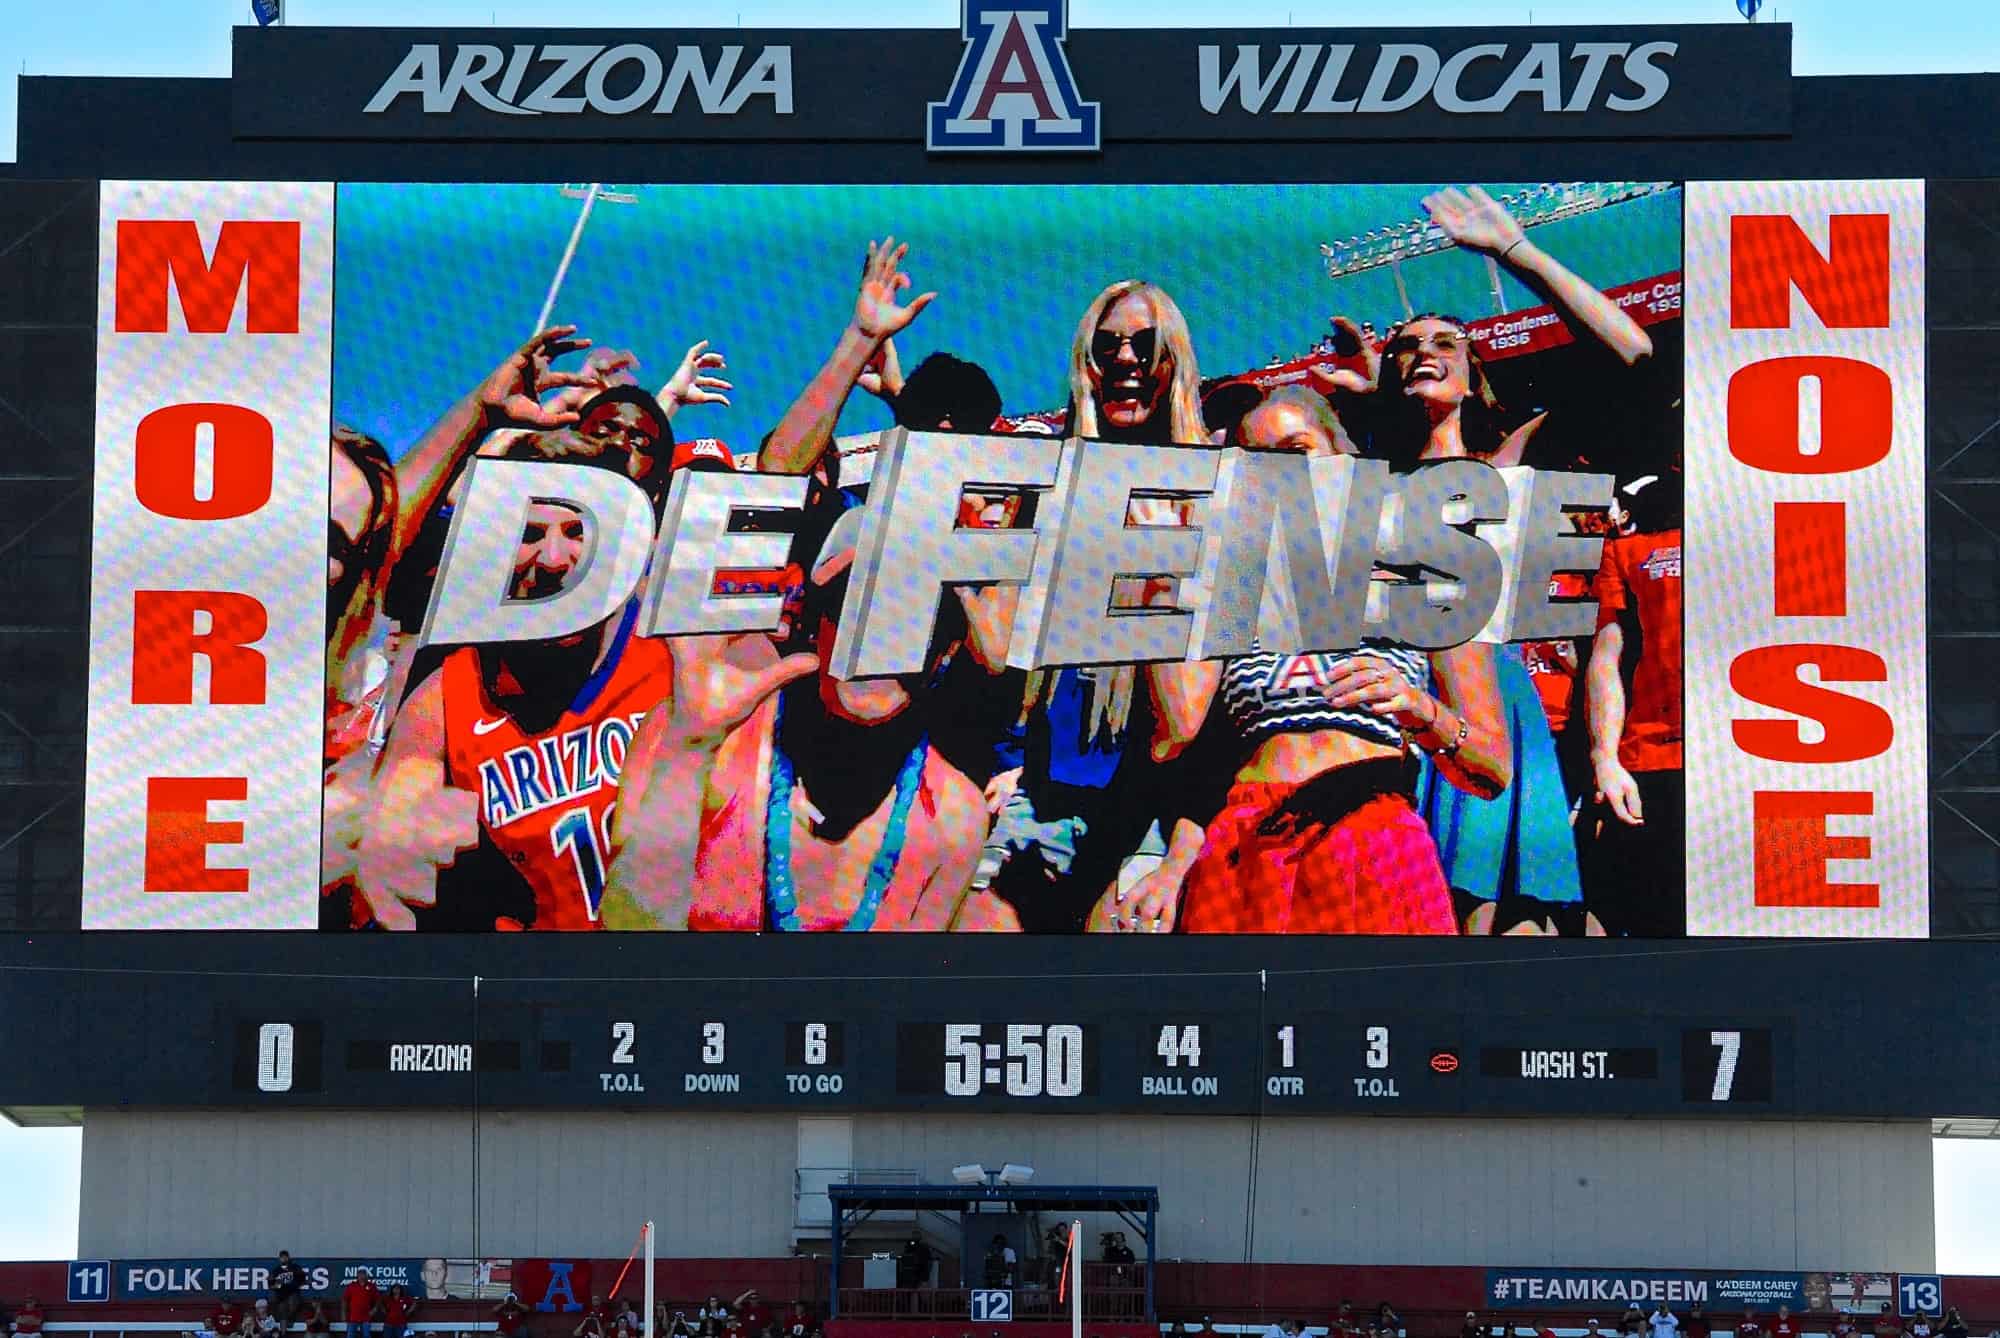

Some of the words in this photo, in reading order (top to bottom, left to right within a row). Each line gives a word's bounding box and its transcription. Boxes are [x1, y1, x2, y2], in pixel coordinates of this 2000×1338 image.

[363, 44, 793, 114] ARIZONA
[925, 0, 1102, 152] A
[1199, 42, 1678, 114] WILDCATS
[419, 427, 1616, 682] DEFENSE
[478, 712, 648, 829] ARIZO
[257, 1023, 294, 1092] 0
[390, 1044, 472, 1072] ARIZONA
[612, 1022, 635, 1064] 2
[702, 1022, 725, 1065] 3
[804, 1023, 827, 1065] 6
[944, 1023, 1083, 1097] 5:50
[1157, 1025, 1201, 1067] 44
[1277, 1025, 1294, 1068] 1
[1366, 1026, 1389, 1069] 3
[684, 1073, 740, 1092] DOWN
[786, 1074, 811, 1093] TO
[815, 1074, 843, 1093] GO
[1521, 1050, 1576, 1079] WASH
[1582, 1051, 1614, 1079] ST.
[1711, 1031, 1741, 1101] 7
[1142, 1076, 1188, 1095] BALL
[1191, 1076, 1218, 1096] ON
[1267, 1076, 1304, 1096] QTR
[75, 1267, 103, 1295] 11
[127, 1268, 203, 1291] FOLK
[212, 1267, 329, 1291] HERES
[344, 1266, 374, 1277] NIK
[376, 1266, 407, 1277] FOLK
[536, 1263, 583, 1312] A
[1494, 1278, 1708, 1303] #TEAMKADEEM
[1764, 1280, 1798, 1291] CAREY
[974, 1292, 1009, 1319] 12
[1902, 1282, 1938, 1311] 13
